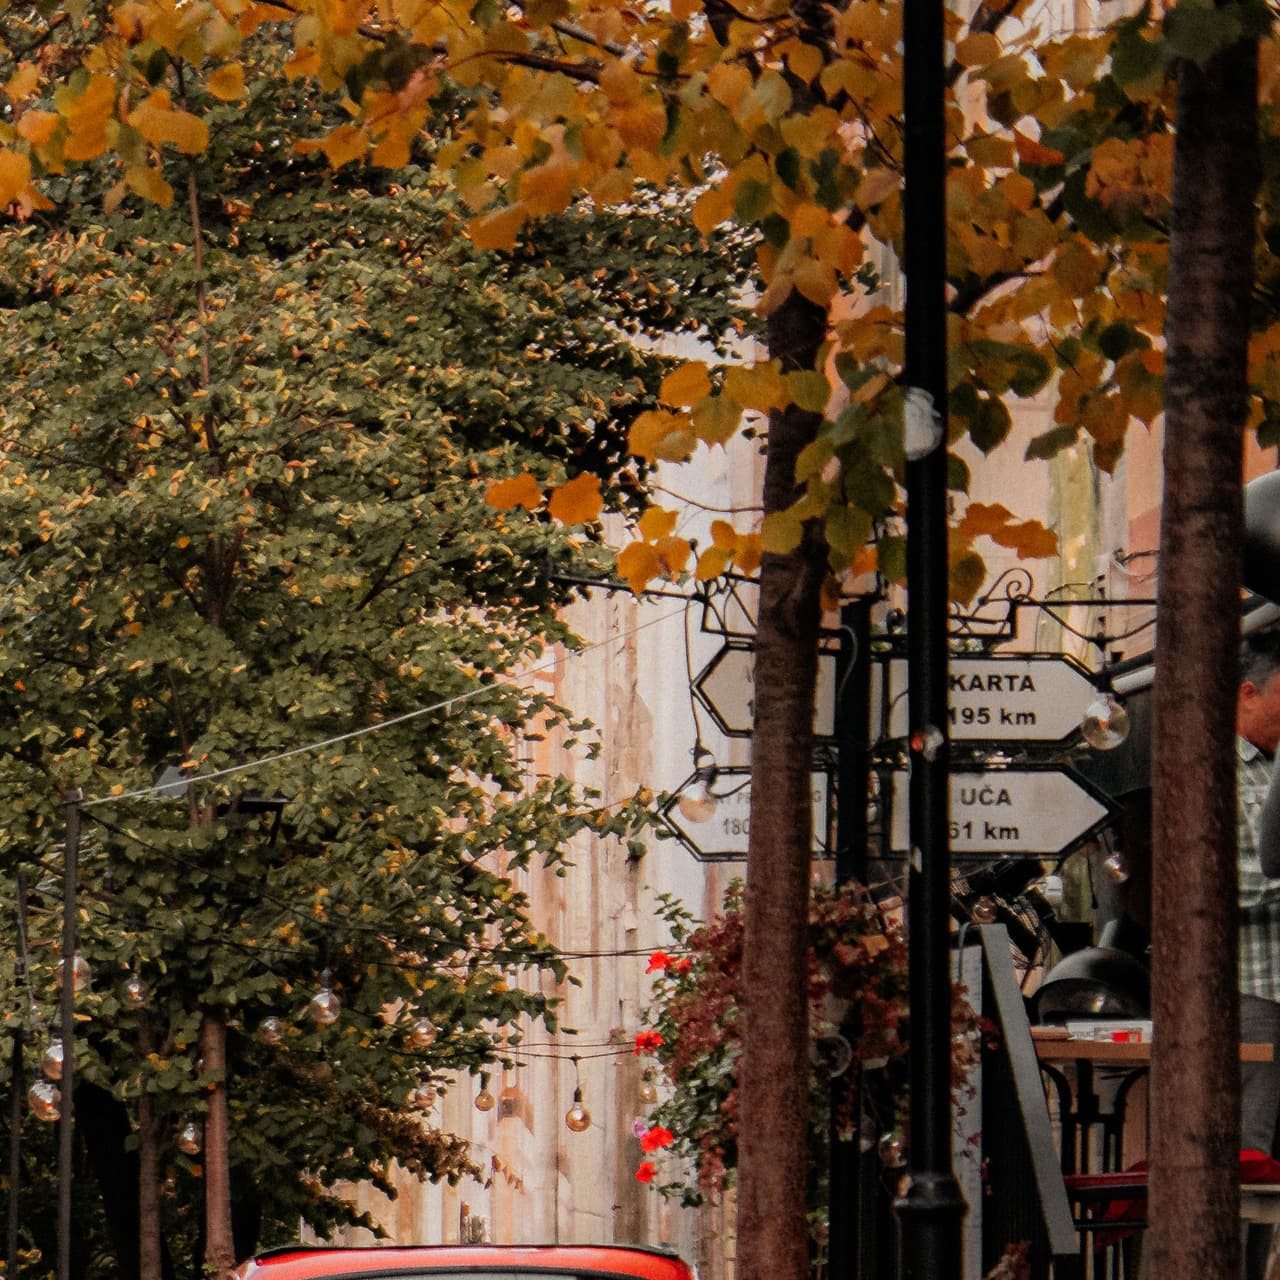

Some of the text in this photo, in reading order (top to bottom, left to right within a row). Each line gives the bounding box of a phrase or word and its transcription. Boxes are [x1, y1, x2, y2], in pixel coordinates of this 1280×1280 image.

[950, 675, 1036, 692] KARTA
[1000, 708, 1036, 725] km
[984, 821, 1020, 840] km
